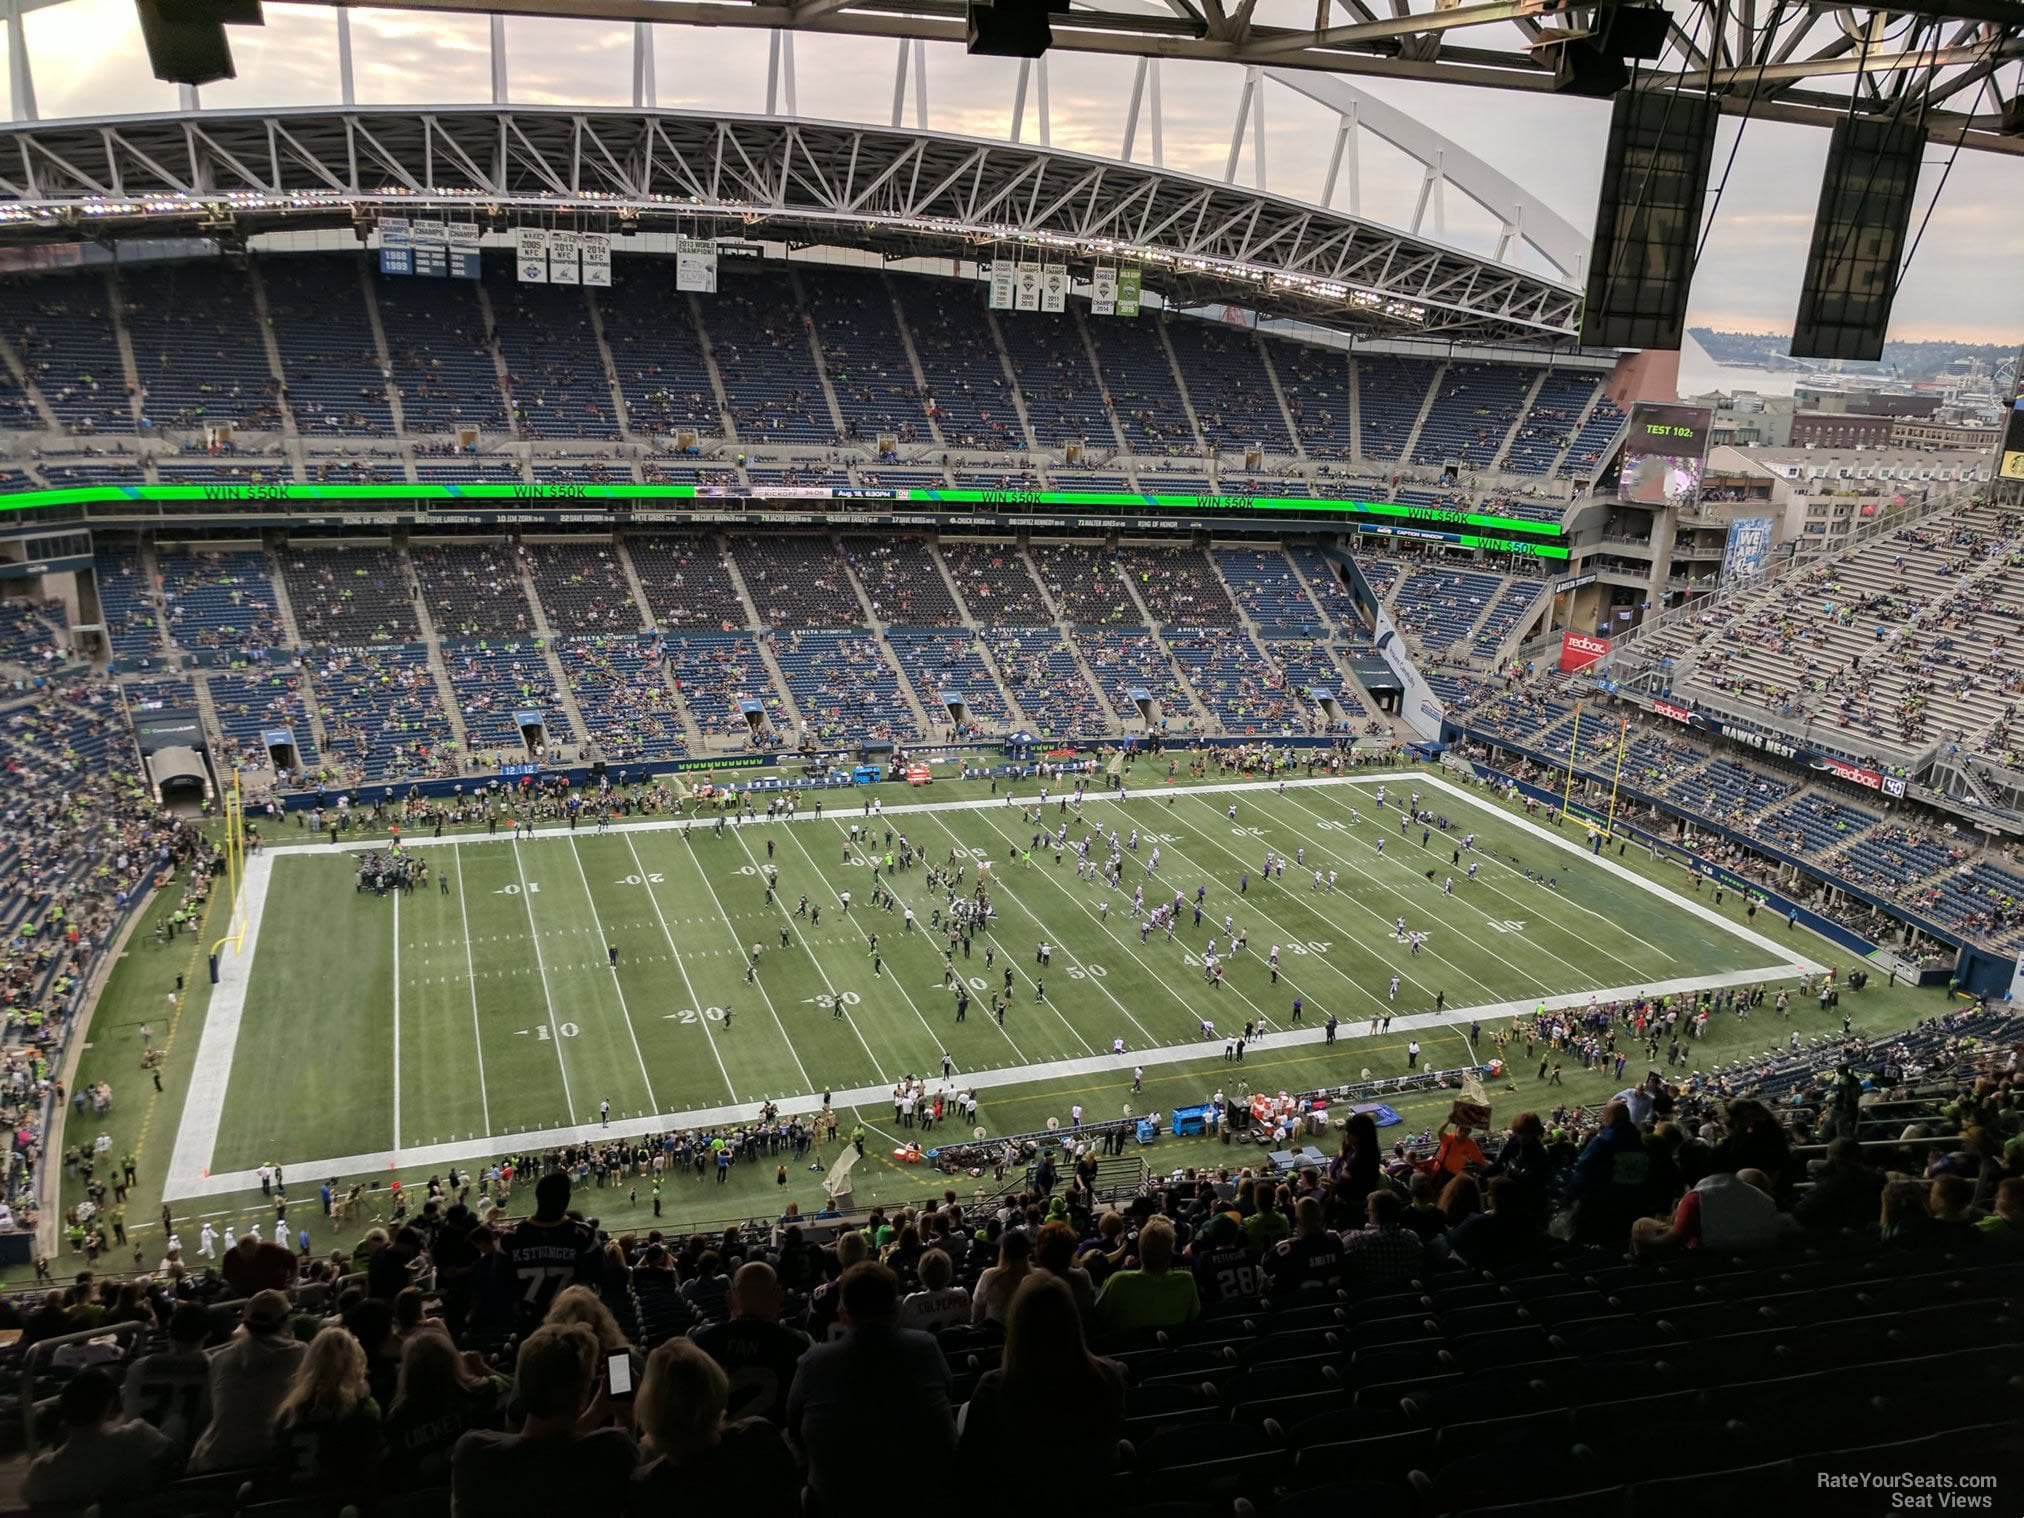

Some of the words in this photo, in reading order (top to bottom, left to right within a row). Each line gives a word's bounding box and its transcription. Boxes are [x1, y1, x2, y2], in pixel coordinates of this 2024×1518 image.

[381, 225, 408, 233] CHAMPS
[416, 228, 444, 236] CHAMPS
[450, 231, 478, 239] CHAMPS
[522, 241, 541, 249] 2005
[554, 243, 574, 252] 2013
[587, 245, 606, 254] 2014
[679, 247, 715, 255] CHAMPIONS
[695, 241, 715, 249] WORLD
[1646, 424, 1672, 435] TEST
[203, 486, 241, 500] WIN
[247, 485, 291, 500] $50K
[513, 485, 544, 498] WIN
[550, 485, 587, 498] $50K
[982, 492, 1008, 504] WIN
[1011, 492, 1041, 504] $50K
[1196, 496, 1221, 508] WIN
[1225, 497, 1254, 509] $50K
[1408, 507, 1433, 521] WIN
[1437, 511, 1469, 525] $50K
[1397, 529, 1420, 537] CAPTION
[1740, 532, 1760, 545] WE
[1477, 537, 1500, 551] WIN
[1506, 541, 1537, 555] $50K
[1568, 636, 1605, 653] redbox
[1600, 680, 1606, 689] 12
[1654, 703, 1686, 720] redbox
[1722, 725, 1763, 748] HAWKS
[1765, 740, 1797, 759] NEST
[506, 766, 516, 775] 12
[524, 765, 534, 773] 12
[1835, 765, 1879, 789] redbox
[1887, 780, 1902, 795] 40
[1487, 920, 1523, 933] 10
[1287, 941, 1327, 955] 30
[1065, 964, 1107, 980] 50
[814, 992, 861, 1008] 30
[677, 1006, 726, 1024] 20
[536, 1022, 580, 1041] 10
[517, 1267, 575, 1304] 77
[1217, 1266, 1255, 1298] 28
